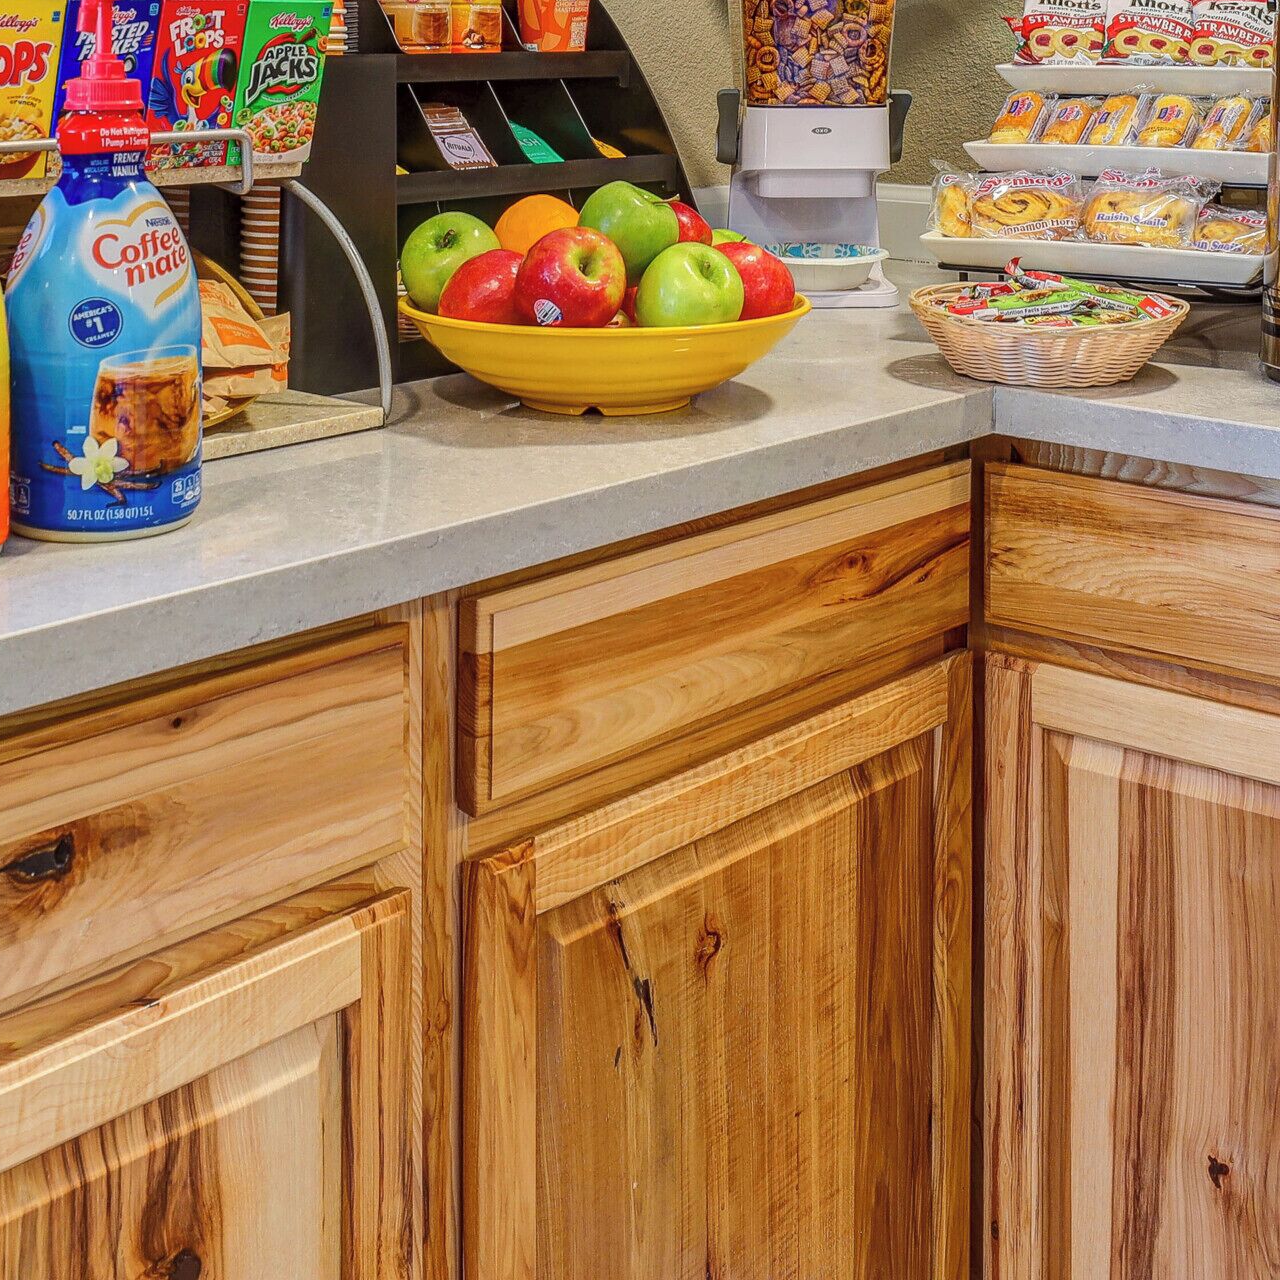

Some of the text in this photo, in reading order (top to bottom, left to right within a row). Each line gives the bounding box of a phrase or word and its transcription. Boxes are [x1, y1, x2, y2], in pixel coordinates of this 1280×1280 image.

[1198, 13, 1241, 25] Premium
[1209, 0, 1274, 26] Knott's
[170, 10, 226, 42] FROOT
[269, 12, 314, 32] Kellogg's
[174, 29, 225, 58] LOOPS
[265, 43, 308, 63] APPLE
[246, 55, 319, 106] JACKS
[100, 127, 123, 137] Do Not
[814, 127, 830, 135] OXO
[105, 138, 124, 149] Pump
[113, 152, 141, 164] FRENCH
[111, 166, 139, 178] VANILLA
[1096, 213, 1167, 228] Raisin Snails
[92, 227, 181, 270] Coffee
[125, 245, 187, 288] mate
[73, 305, 114, 321] AMERICA'S
[1025, 306, 1040, 314] Facts
[86, 317, 104, 333] #1
[67, 506, 154, 521] 50.7 FL OZ (1.58 QT) 1.5 L
